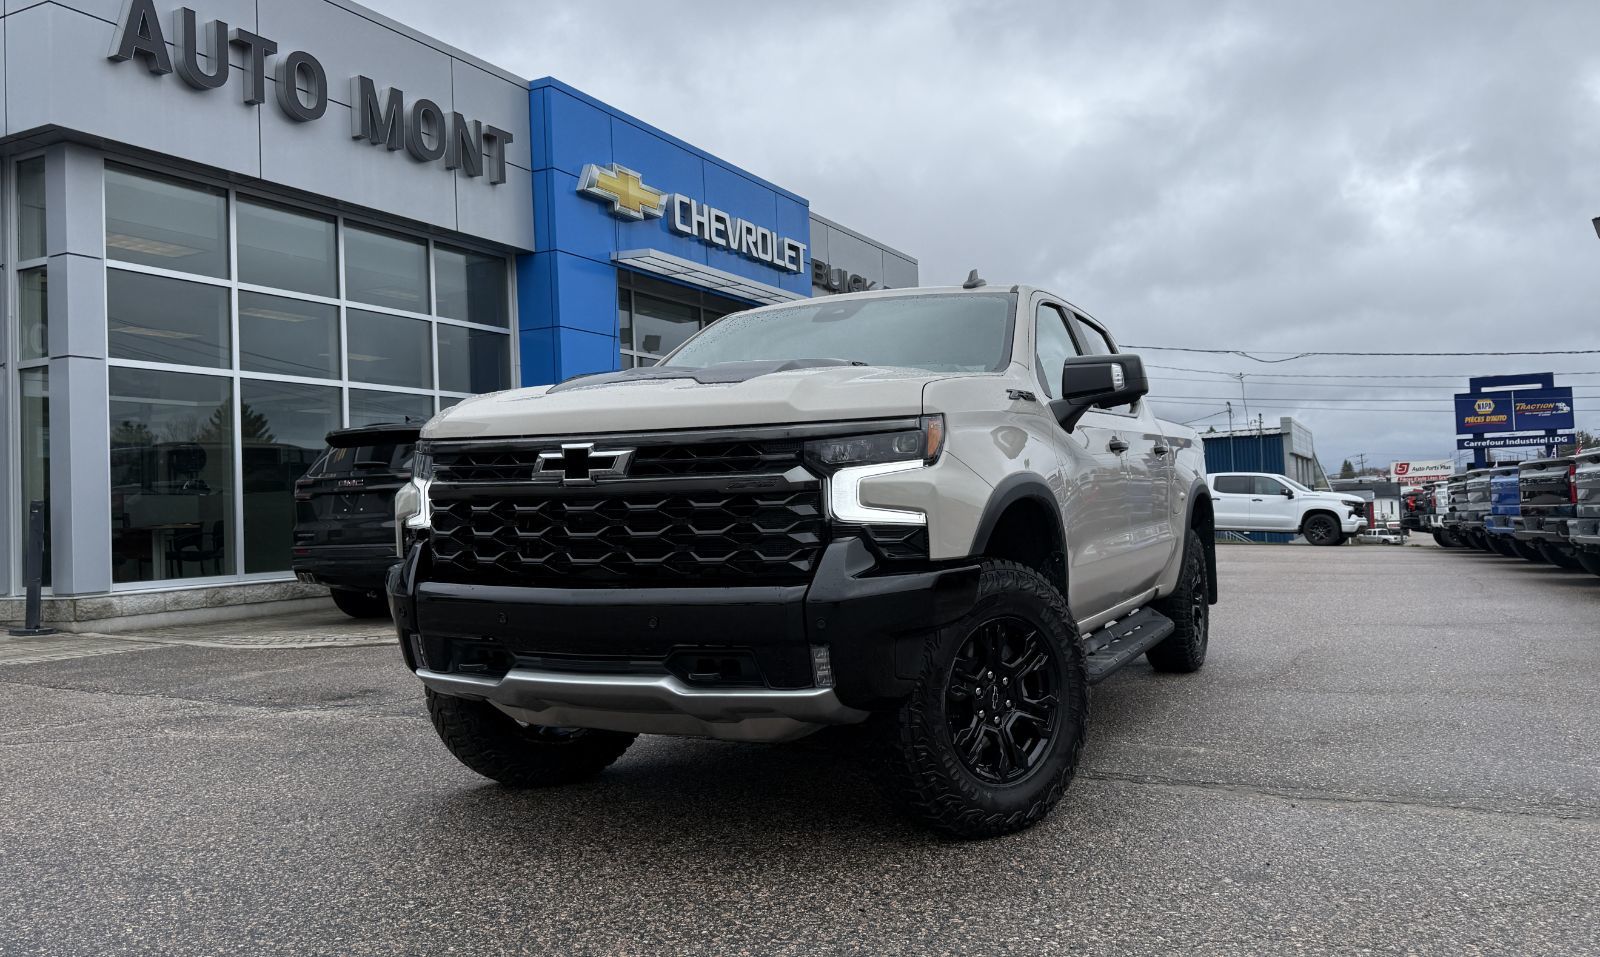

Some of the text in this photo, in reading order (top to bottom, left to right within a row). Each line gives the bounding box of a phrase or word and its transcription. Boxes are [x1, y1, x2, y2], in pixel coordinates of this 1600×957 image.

[107, 0, 514, 185] AUTO MONT
[669, 192, 807, 274] CHEVROLET
[1477, 401, 1493, 411] NAPA
[1464, 439, 1504, 447] Carrefour
[1506, 437, 1547, 446] Industriel
[338, 479, 364, 487] GMC
